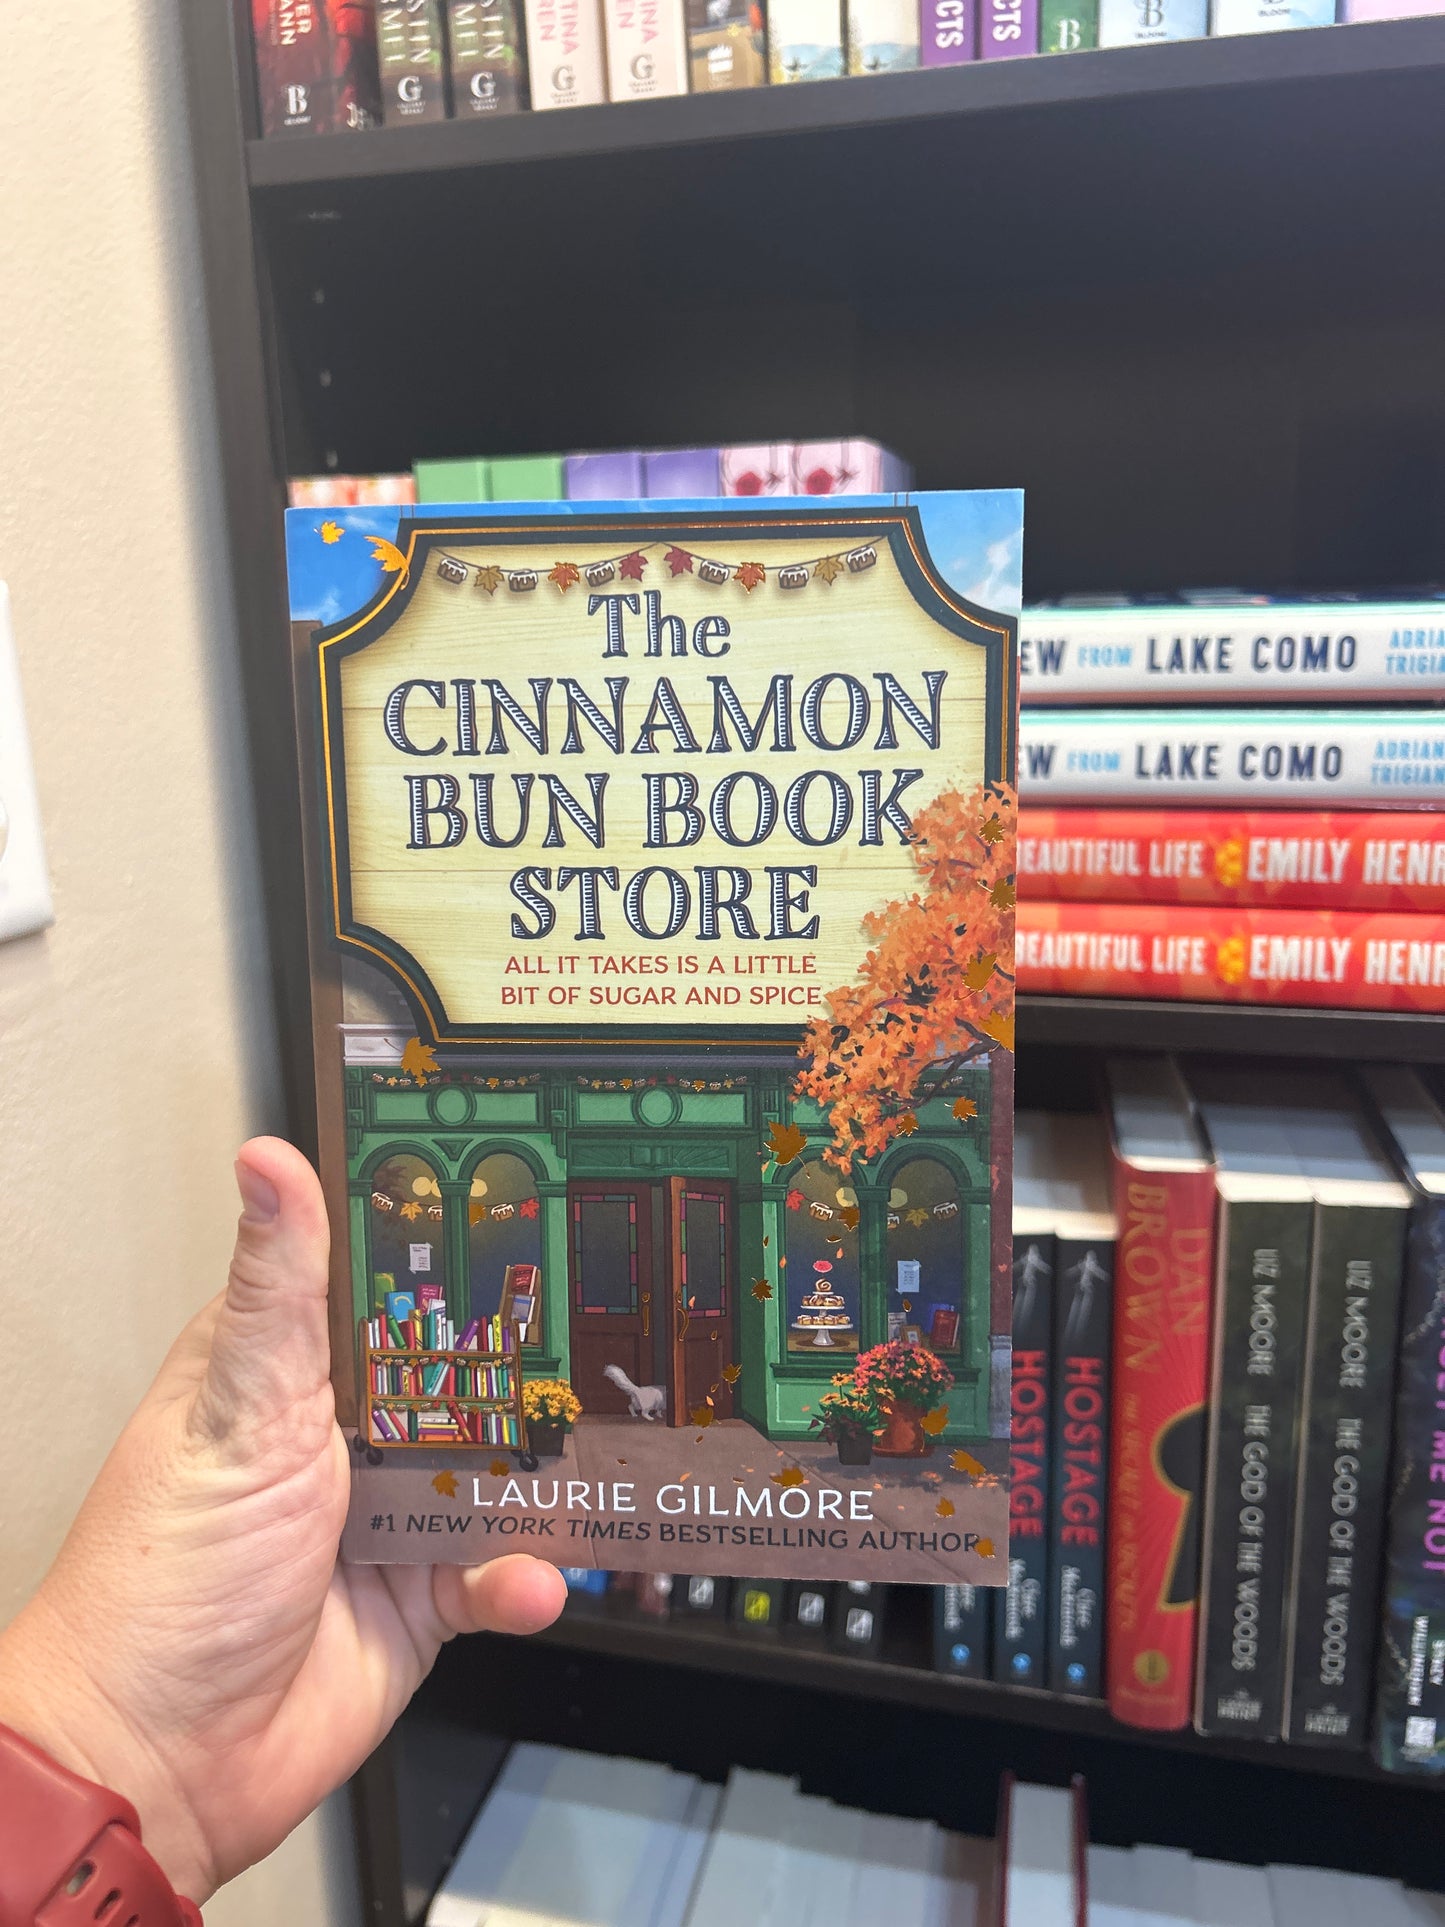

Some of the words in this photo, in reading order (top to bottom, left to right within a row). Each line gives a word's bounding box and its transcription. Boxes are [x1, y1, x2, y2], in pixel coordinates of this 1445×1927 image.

[287, 84, 307, 115] B
[397, 75, 422, 102] G
[470, 71, 496, 98] G
[588, 590, 732, 658] The
[1077, 645, 1133, 668] FROM
[1145, 636, 1233, 674] LAKE
[1250, 635, 1358, 674] COMO
[383, 670, 948, 757] CINNAMON
[1067, 751, 1122, 773] FROM
[1134, 744, 1219, 781] LAKE
[1238, 745, 1343, 781] COMO
[405, 771, 610, 850] BUN
[641, 768, 928, 848] BOOK
[1149, 840, 1204, 879] LIFE
[1247, 837, 1351, 884] EMILY
[509, 864, 821, 942] STORE
[504, 955, 552, 975] ALL
[557, 955, 582, 975] IT
[588, 955, 670, 975] TAKES
[677, 955, 700, 975] IS
[707, 955, 727, 975] A
[734, 953, 817, 975] LITTLE
[1152, 935, 1205, 975] LIFE
[1250, 935, 1353, 983] EMILY
[501, 986, 541, 1006] BIT
[548, 986, 582, 1006] OF
[589, 986, 677, 1006] SUGAR
[681, 986, 743, 1006] AND
[750, 986, 822, 1006] SPICE
[1124, 1181, 1168, 1374] BROWN
[1163, 1227, 1208, 1337] DAN
[1247, 1284, 1278, 1377] MOORE
[1339, 1296, 1369, 1389] MOORE
[1244, 1404, 1272, 1437] THE
[1335, 1417, 1363, 1450] THE
[1010, 1350, 1046, 1540] HOSTAGE
[1060, 1356, 1104, 1549] HOSTAGE
[1240, 1441, 1269, 1502] GOD
[1331, 1454, 1361, 1516] GOD
[472, 1478, 637, 1512] LAURIE
[655, 1484, 875, 1521] GILMORE
[1238, 1506, 1266, 1537] OF
[370, 1514, 397, 1532] #1
[405, 1514, 473, 1535] NEW
[483, 1516, 556, 1538] YORK
[566, 1519, 652, 1541] TIMES
[659, 1523, 851, 1550] BESTSELLING
[857, 1530, 983, 1554] AUTHOR
[1236, 1541, 1263, 1574] THE
[1329, 1520, 1355, 1550] OF
[1326, 1555, 1353, 1587] THE
[1231, 1577, 1260, 1672] WOODS
[1320, 1592, 1350, 1686] WOODS
